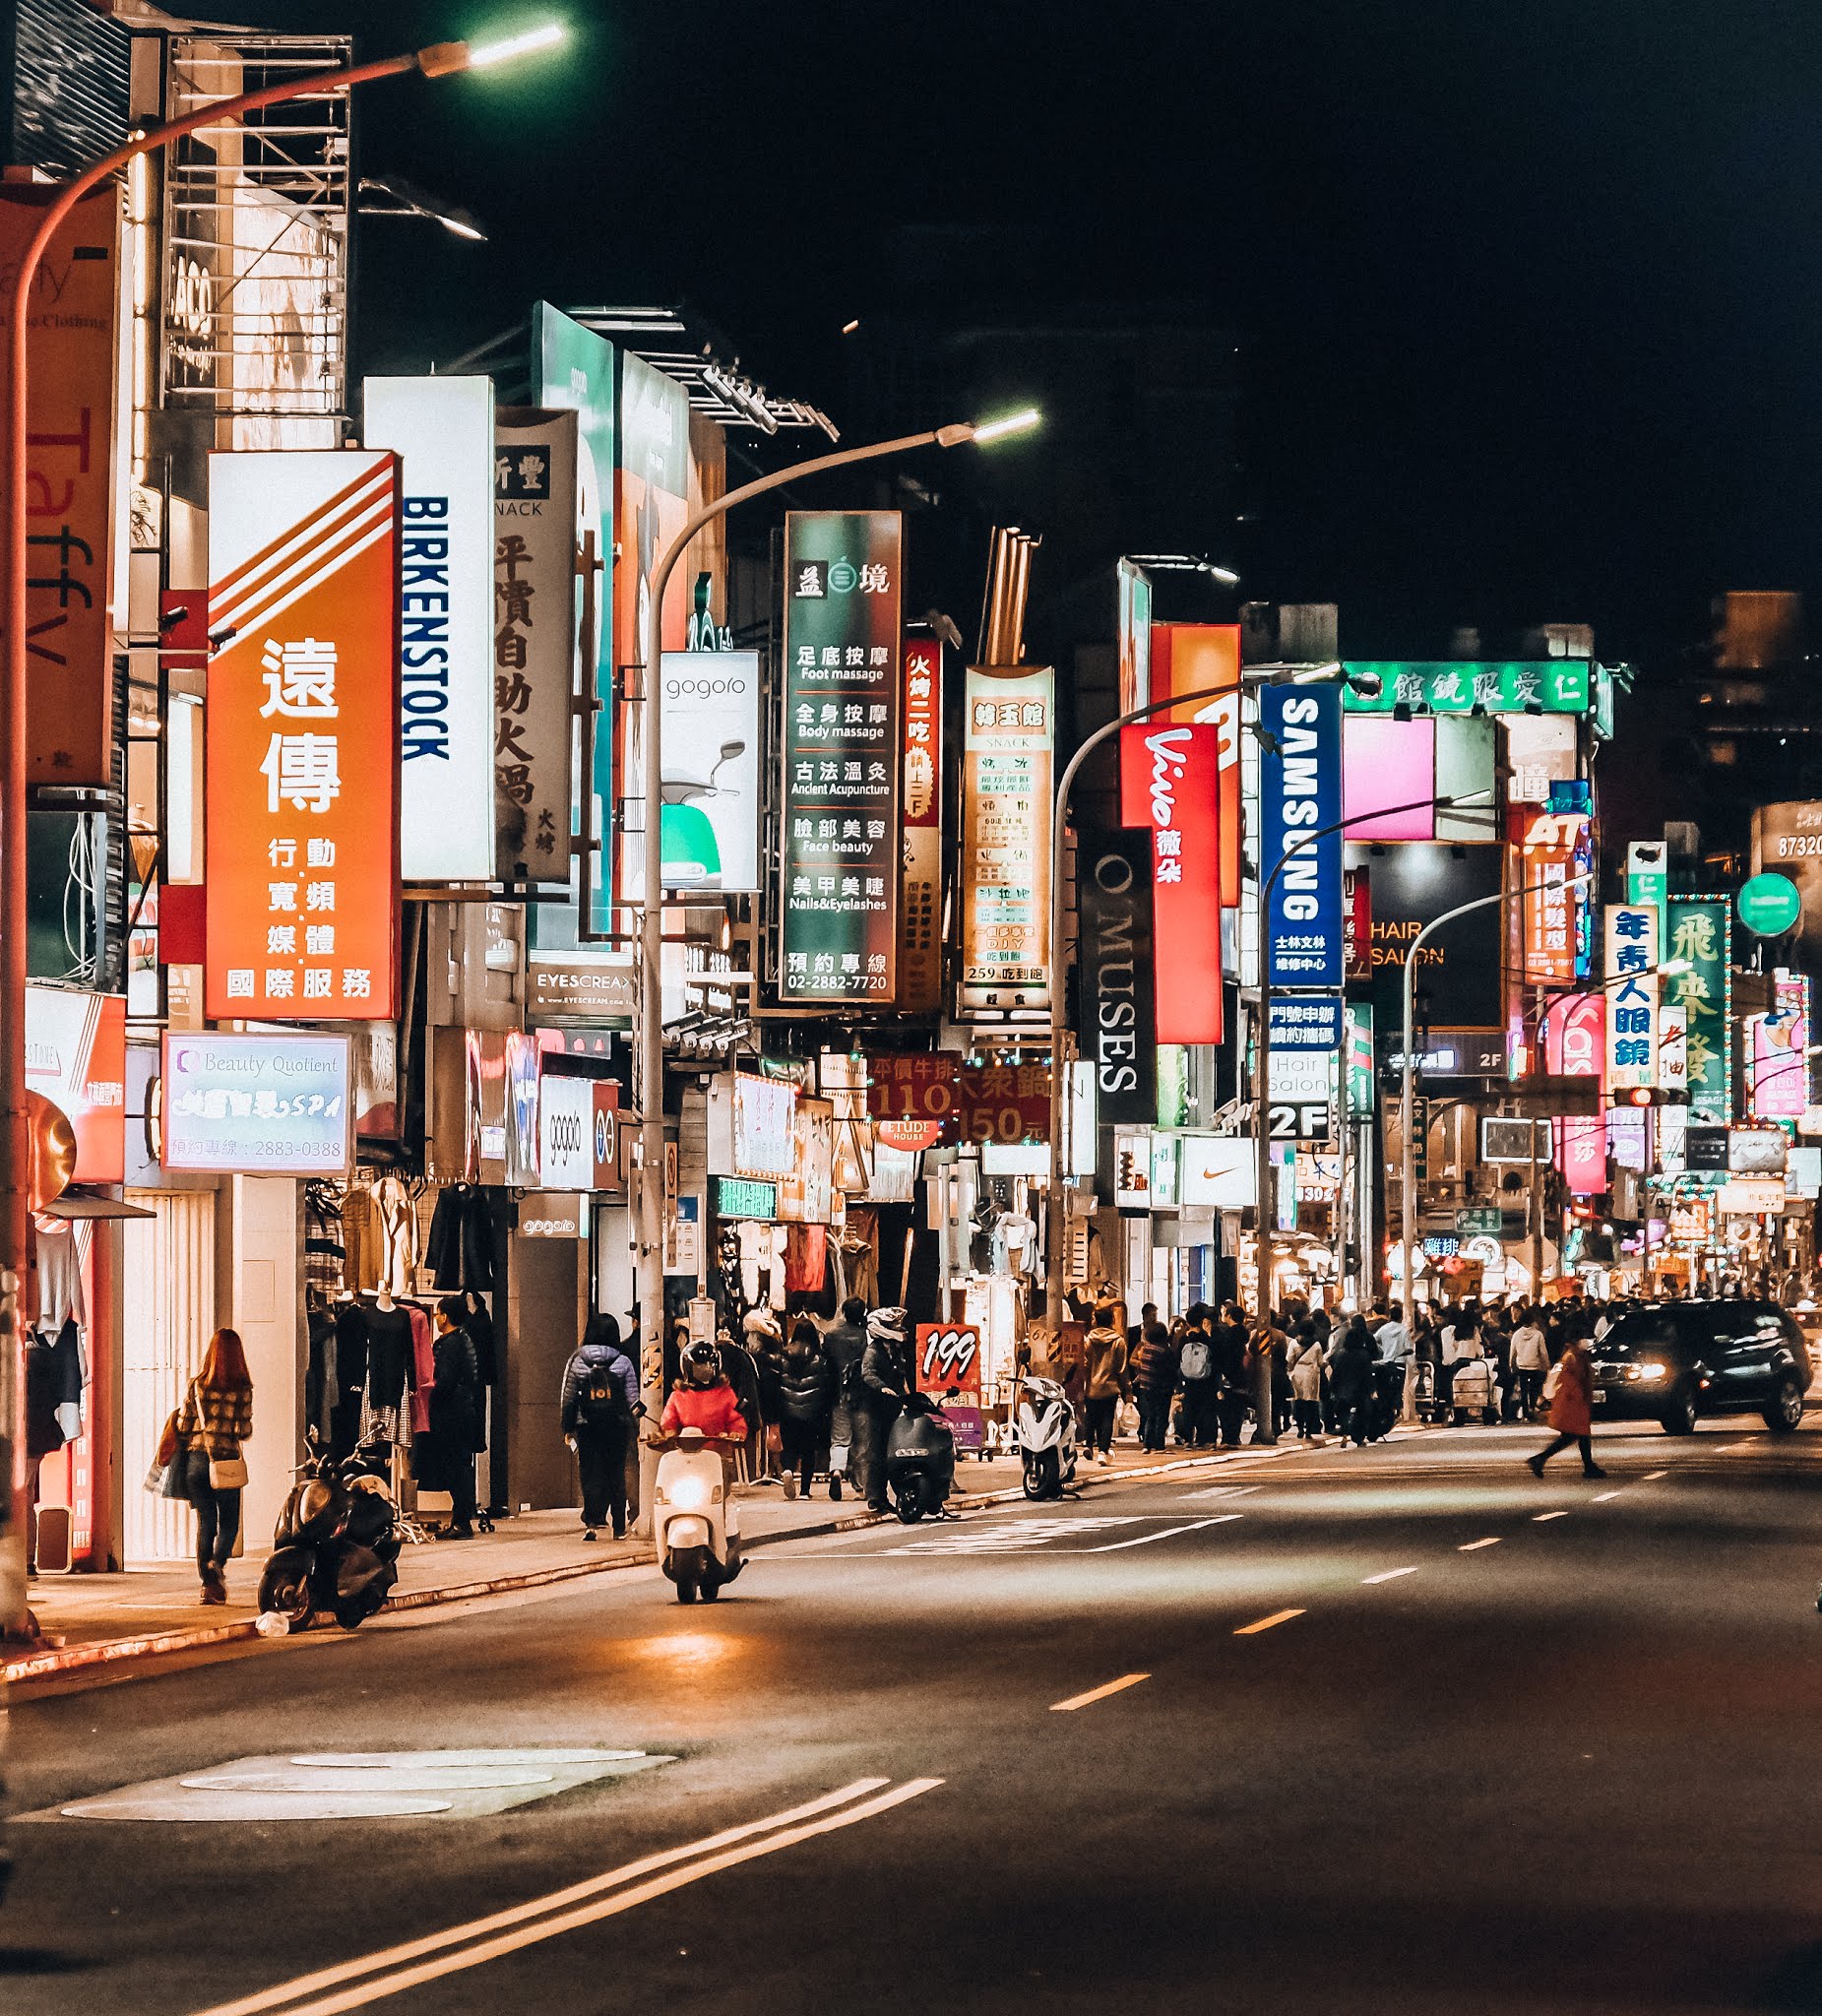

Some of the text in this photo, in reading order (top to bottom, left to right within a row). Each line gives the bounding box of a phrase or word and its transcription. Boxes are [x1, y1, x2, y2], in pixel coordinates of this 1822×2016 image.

[495, 502, 542, 516] NACK
[403, 496, 450, 761] BIRKENSTOCK
[796, 645, 889, 665] 足底按摩
[801, 666, 884, 683] Foot massage
[666, 676, 746, 699] gogoro
[908, 654, 932, 743] 火烤二吃
[795, 703, 888, 724] 全身按摩
[259, 637, 342, 814] 遠傳
[798, 724, 885, 740] Body massage
[985, 737, 1030, 748] SNACK
[791, 783, 890, 796] Ancient Acupuncture
[1282, 697, 1319, 921] SAMSUNG
[793, 819, 886, 839] 臉部美容
[267, 838, 336, 868] 行動
[802, 840, 874, 855] Face beauty
[267, 882, 336, 912] 寬頻
[788, 897, 888, 912] Nails&Eyelashes
[266, 924, 336, 955] 媒體
[1370, 921, 1422, 939] HAIR
[985, 938, 1025, 950] DIY
[1275, 935, 1326, 950] 士林文林
[787, 952, 887, 974] 預約專線
[1275, 957, 1326, 972] 維修中心
[1370, 947, 1446, 966] SALON
[226, 969, 372, 999] 國際服務
[787, 975, 887, 990] 02-2882-7720
[1269, 1005, 1335, 1024] 門號申辦
[206, 1052, 339, 1078] Beauty Quotient
[873, 1058, 953, 1080] 平價牛排
[1277, 1057, 1317, 1072] Hair
[1479, 1053, 1502, 1067] 2F
[1268, 1076, 1327, 1092] Salon
[877, 1084, 952, 1114] 110
[887, 1122, 930, 1133] ETUDE
[1268, 1104, 1328, 1137] 2F
[255, 1140, 342, 1157] 2883-0388
[523, 1220, 576, 1235] gogoro
[922, 1329, 976, 1381] 199
